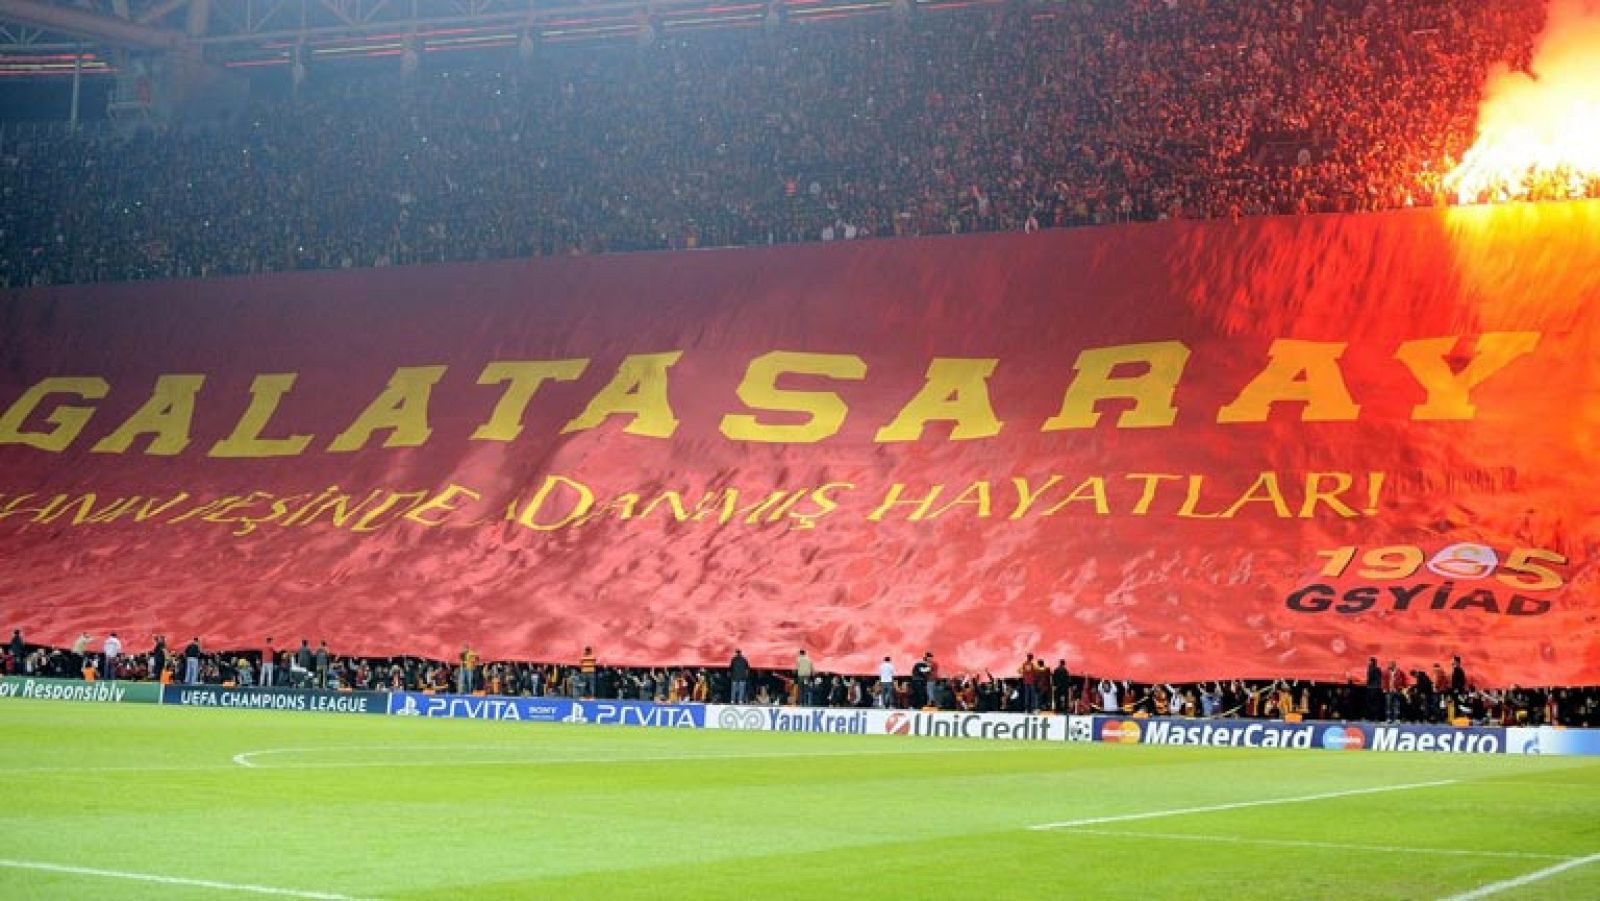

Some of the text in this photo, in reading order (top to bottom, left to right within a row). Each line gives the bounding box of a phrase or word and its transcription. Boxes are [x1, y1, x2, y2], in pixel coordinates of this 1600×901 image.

[0, 331, 1540, 457] GALATASARAY
[867, 471, 1384, 521] HAYATLAR!
[22, 679, 126, 702] Responsibly
[181, 690, 368, 712] UEFA CHAMPIONS LEAGUE
[914, 714, 1051, 741] UniCredit
[1145, 720, 1313, 748] MasterCard
[1373, 727, 1498, 753] Maestro
